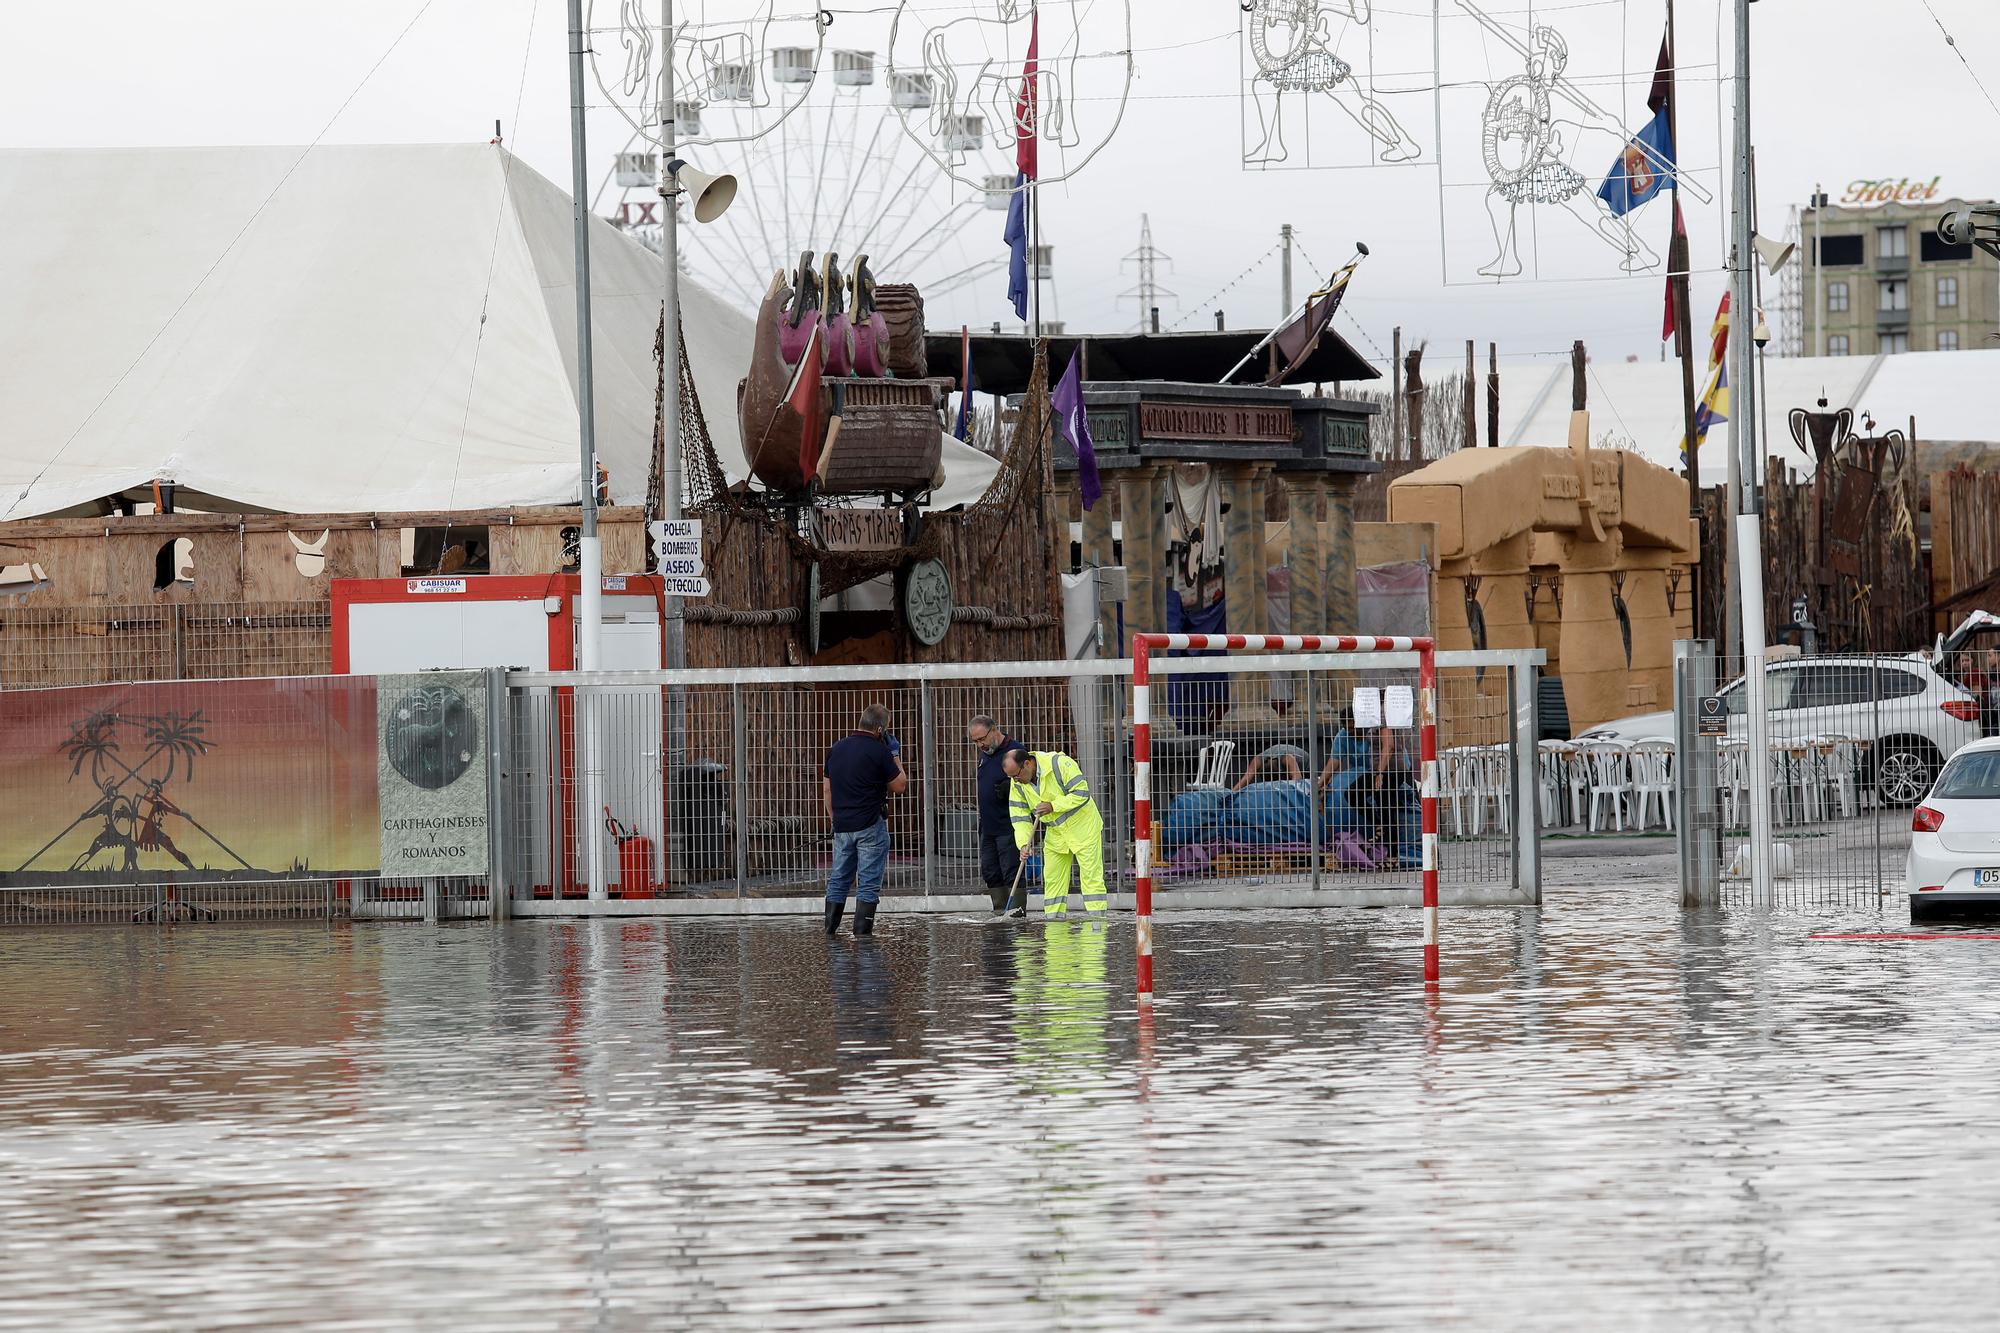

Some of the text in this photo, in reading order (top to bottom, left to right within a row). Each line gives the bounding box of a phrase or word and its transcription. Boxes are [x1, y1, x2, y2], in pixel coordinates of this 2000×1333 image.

[1841, 176, 1941, 203] Hotel
[662, 541, 698, 555] BOMBEROS
[665, 560, 695, 574] ASEOS
[384, 816, 485, 830] CARTHAGINESES
[429, 832, 437, 843] Y
[402, 846, 466, 858] ROMANOS
